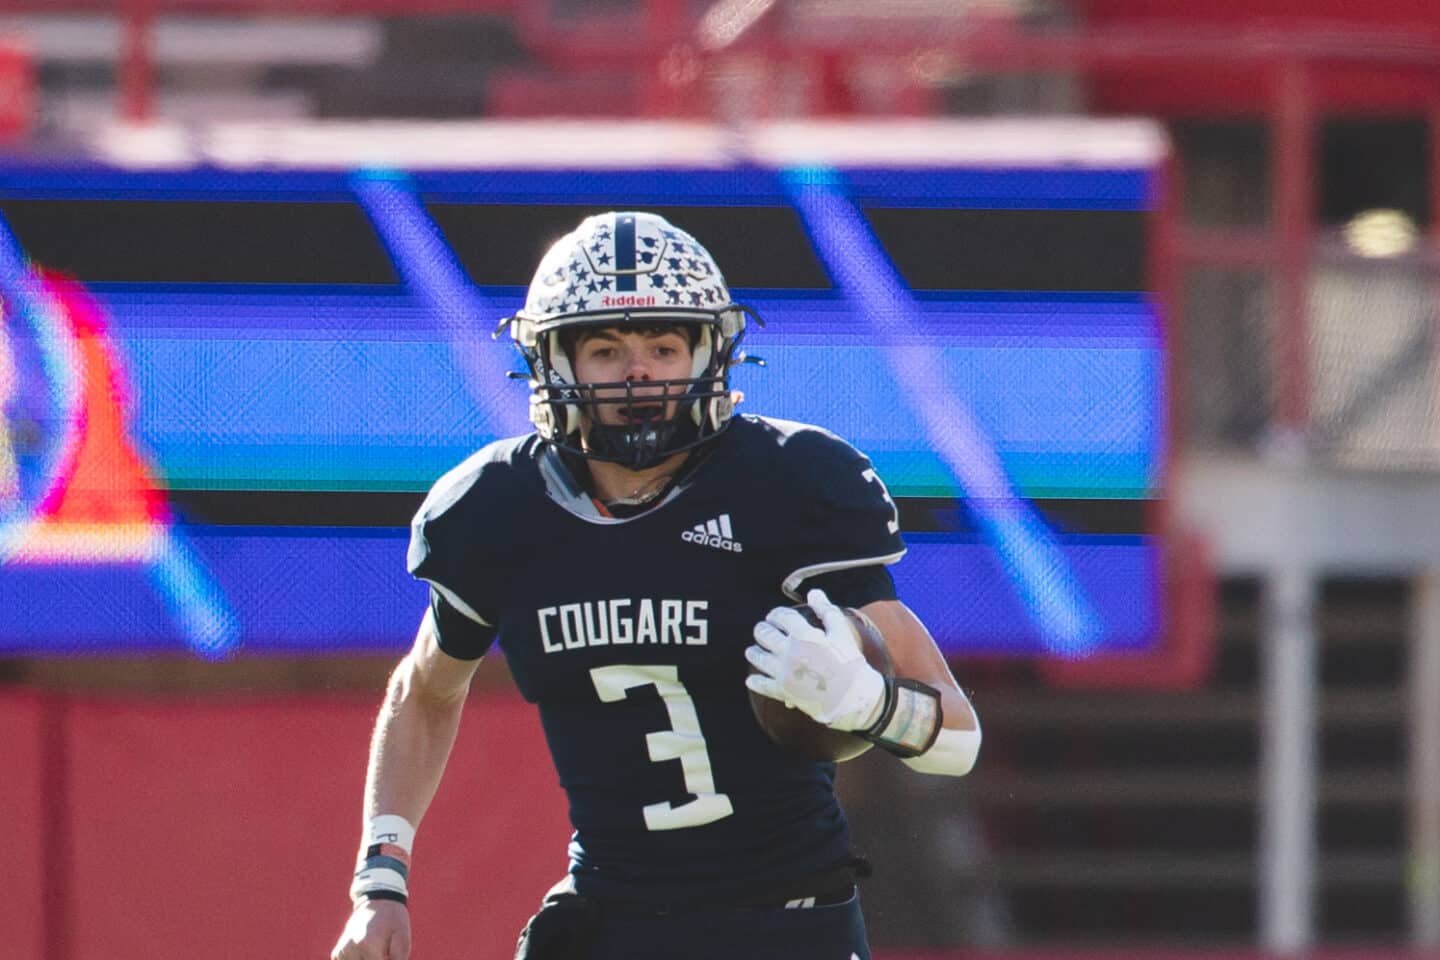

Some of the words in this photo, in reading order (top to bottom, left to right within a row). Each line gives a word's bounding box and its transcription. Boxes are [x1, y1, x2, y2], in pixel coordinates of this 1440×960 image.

[602, 295, 656, 307] Riddell
[681, 529, 743, 553] adidas
[537, 598, 709, 654] COUGARS
[589, 664, 734, 831] 3
